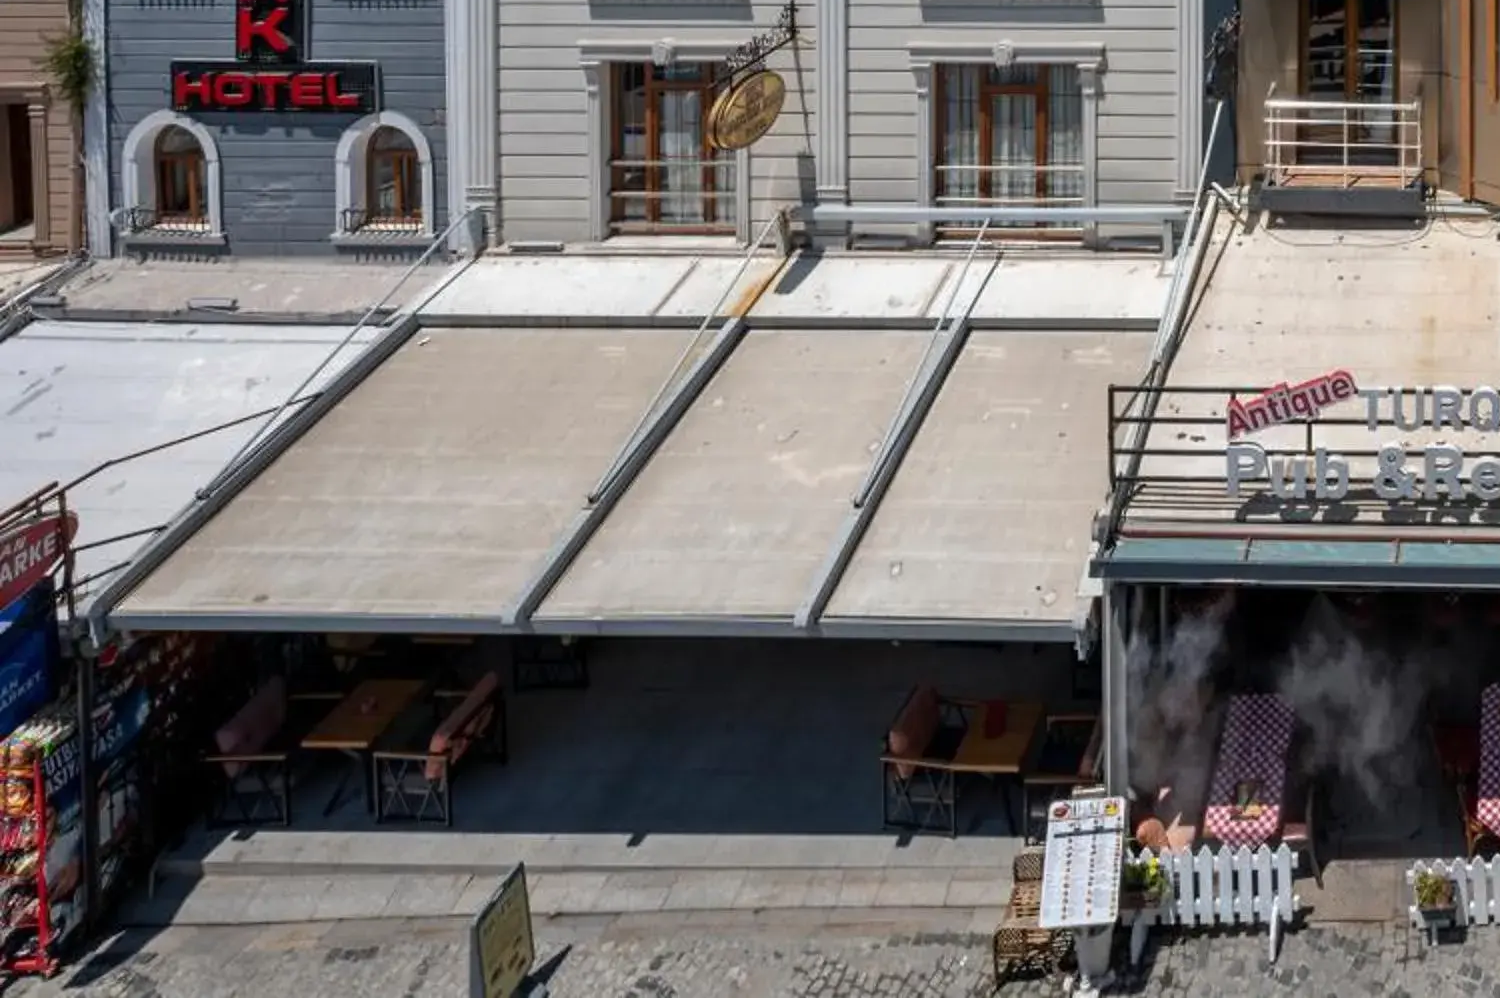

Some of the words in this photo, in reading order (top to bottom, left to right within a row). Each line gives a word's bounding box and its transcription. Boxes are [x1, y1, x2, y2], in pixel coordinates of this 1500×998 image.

[175, 71, 361, 108] HOTEL
[1226, 370, 1358, 440] Antique
[1225, 440, 1350, 499] Pub
[0, 530, 60, 589] ARKE
